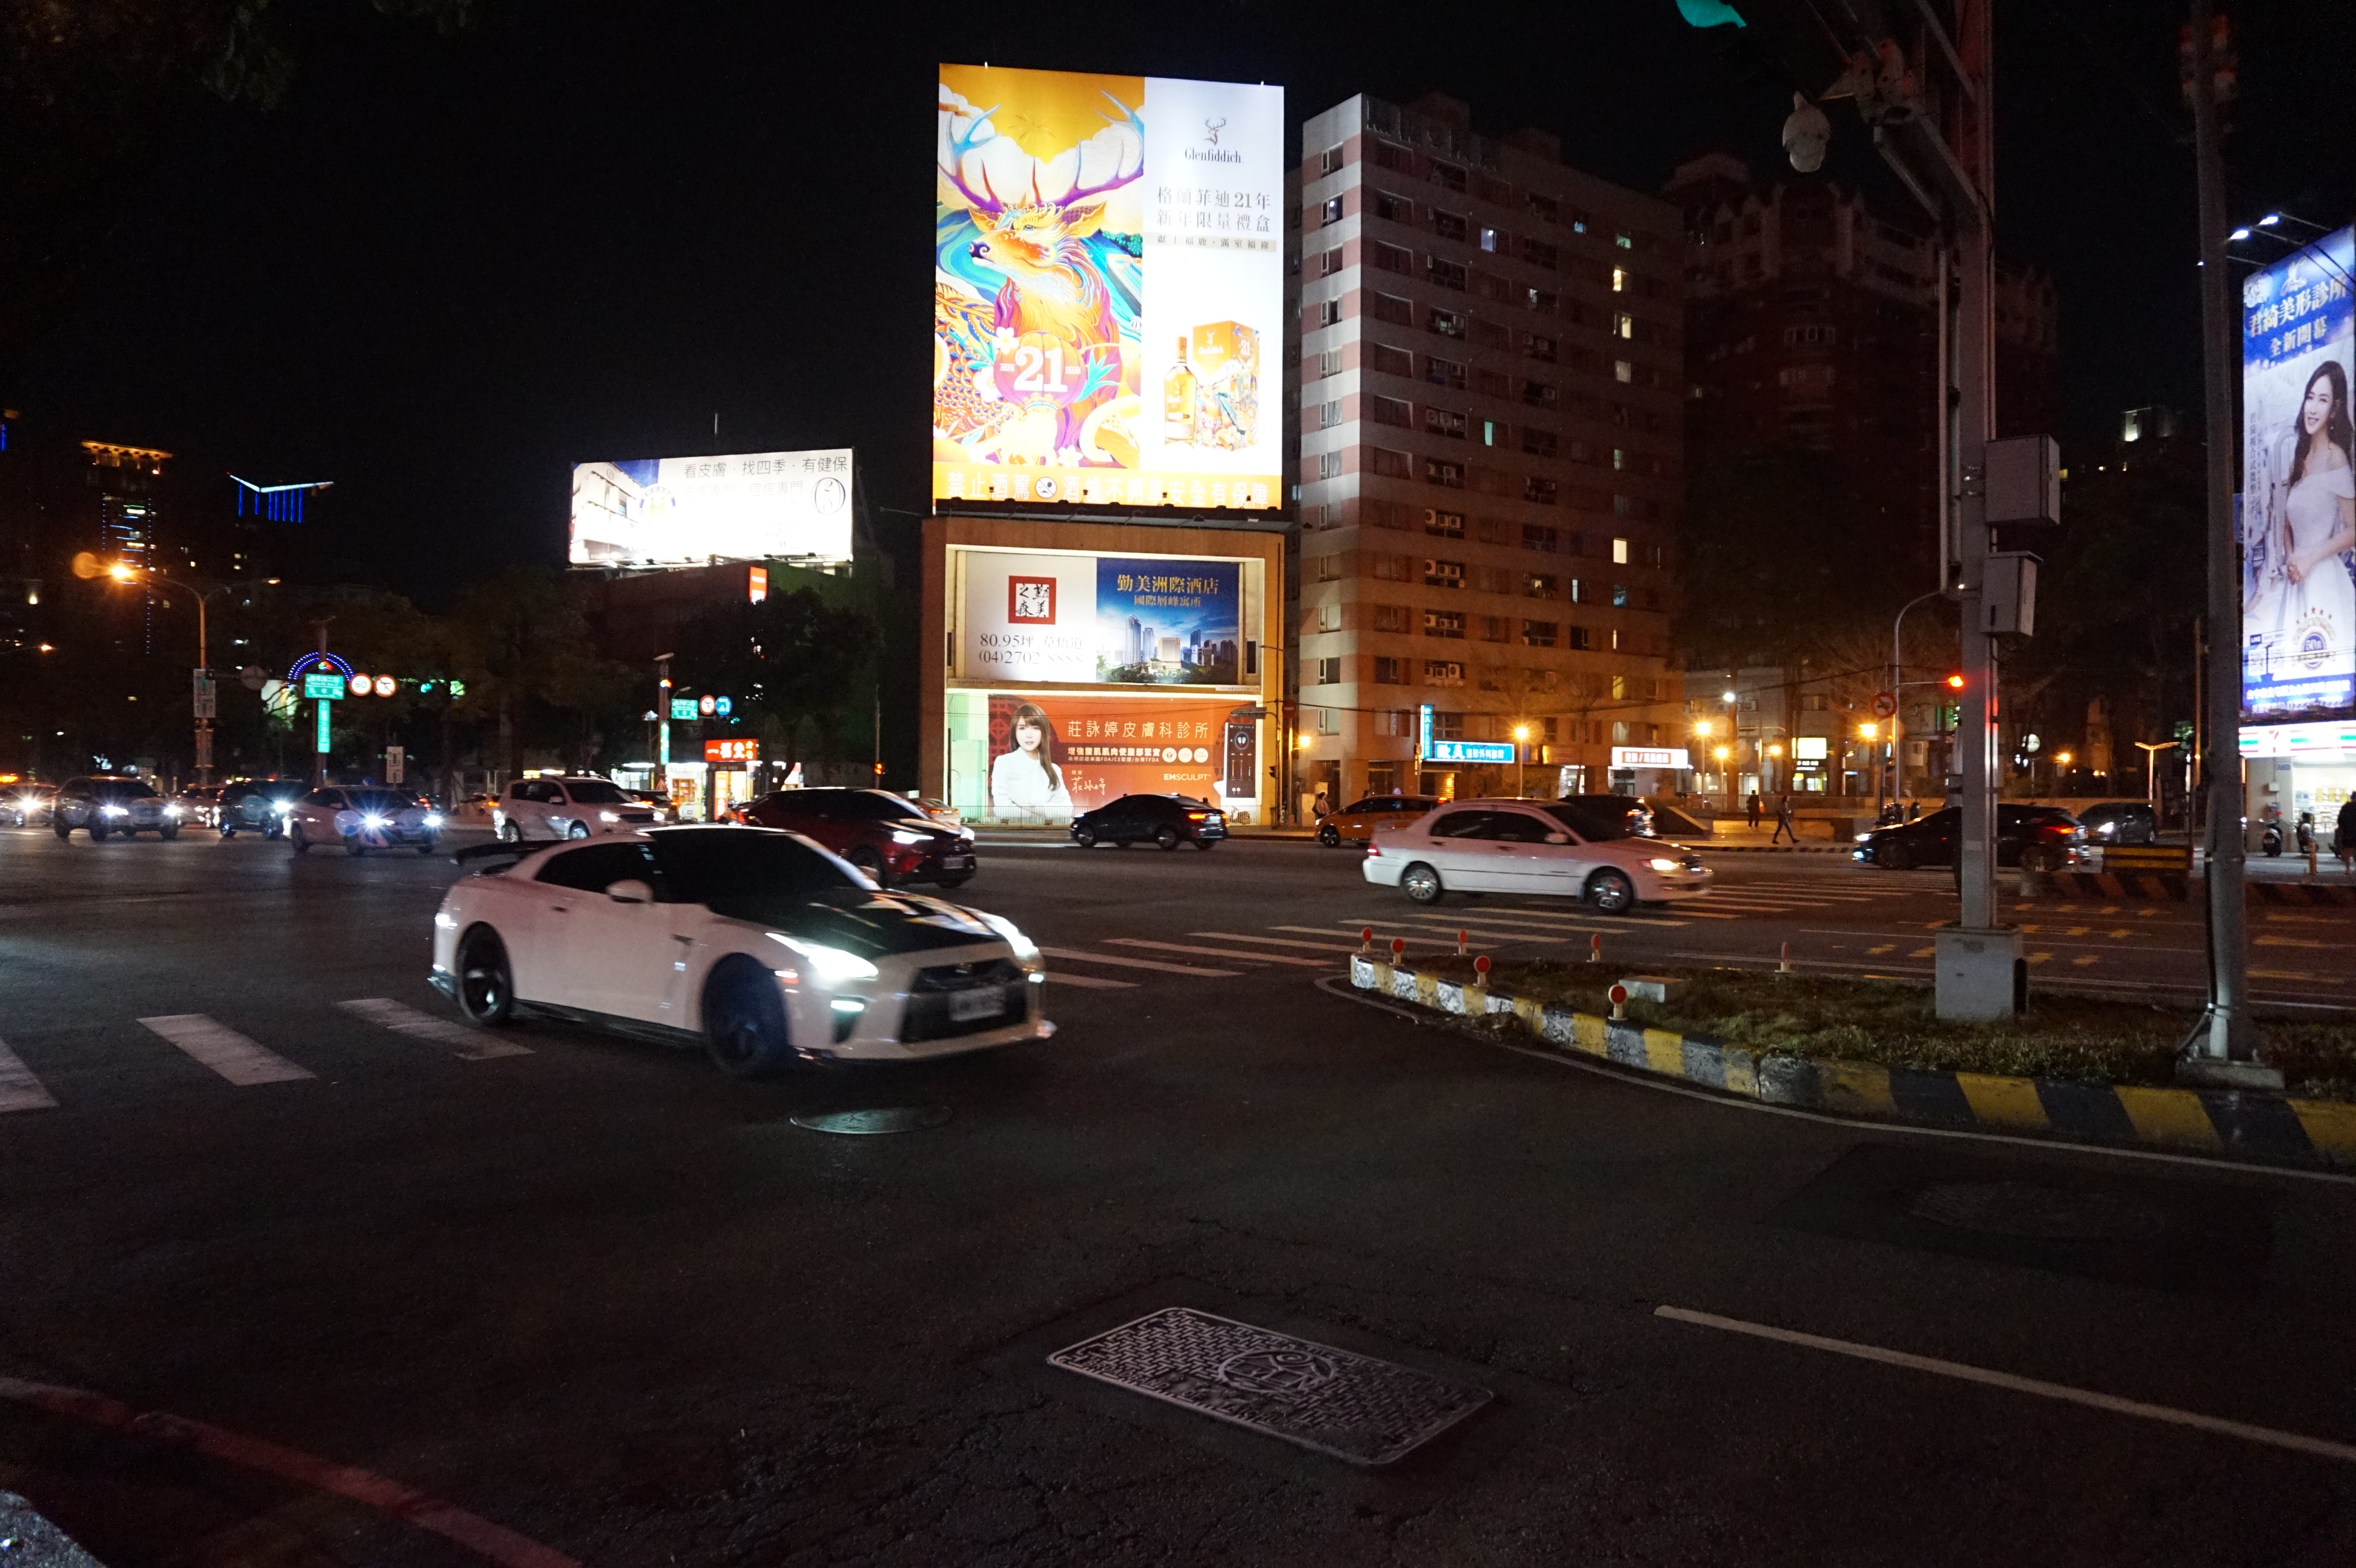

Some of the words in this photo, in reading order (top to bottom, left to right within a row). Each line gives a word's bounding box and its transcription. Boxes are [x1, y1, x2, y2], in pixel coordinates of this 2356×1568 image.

[1185, 147, 1241, 163] Glenfiddich
[1157, 186, 1271, 210] 格蘭菲迪21年
[1157, 209, 1271, 232] 新年限量禮盒
[2249, 274, 2347, 338] 君綺美形診所
[2270, 316, 2328, 358] 全新開幕
[1013, 346, 1068, 392] 21
[947, 471, 1030, 501] 禁止酒駕
[1063, 475, 1269, 509] 酒後不開車安全有保障
[1117, 574, 1219, 594] 勤美洲際酒店
[980, 633, 1034, 648] 80.95坪
[355, 680, 367, 689] 60
[1068, 720, 1208, 739] 莊詠婷皮膚科診所
[1068, 747, 1160, 756] 增強腹肌肌肉使腹部緊實
